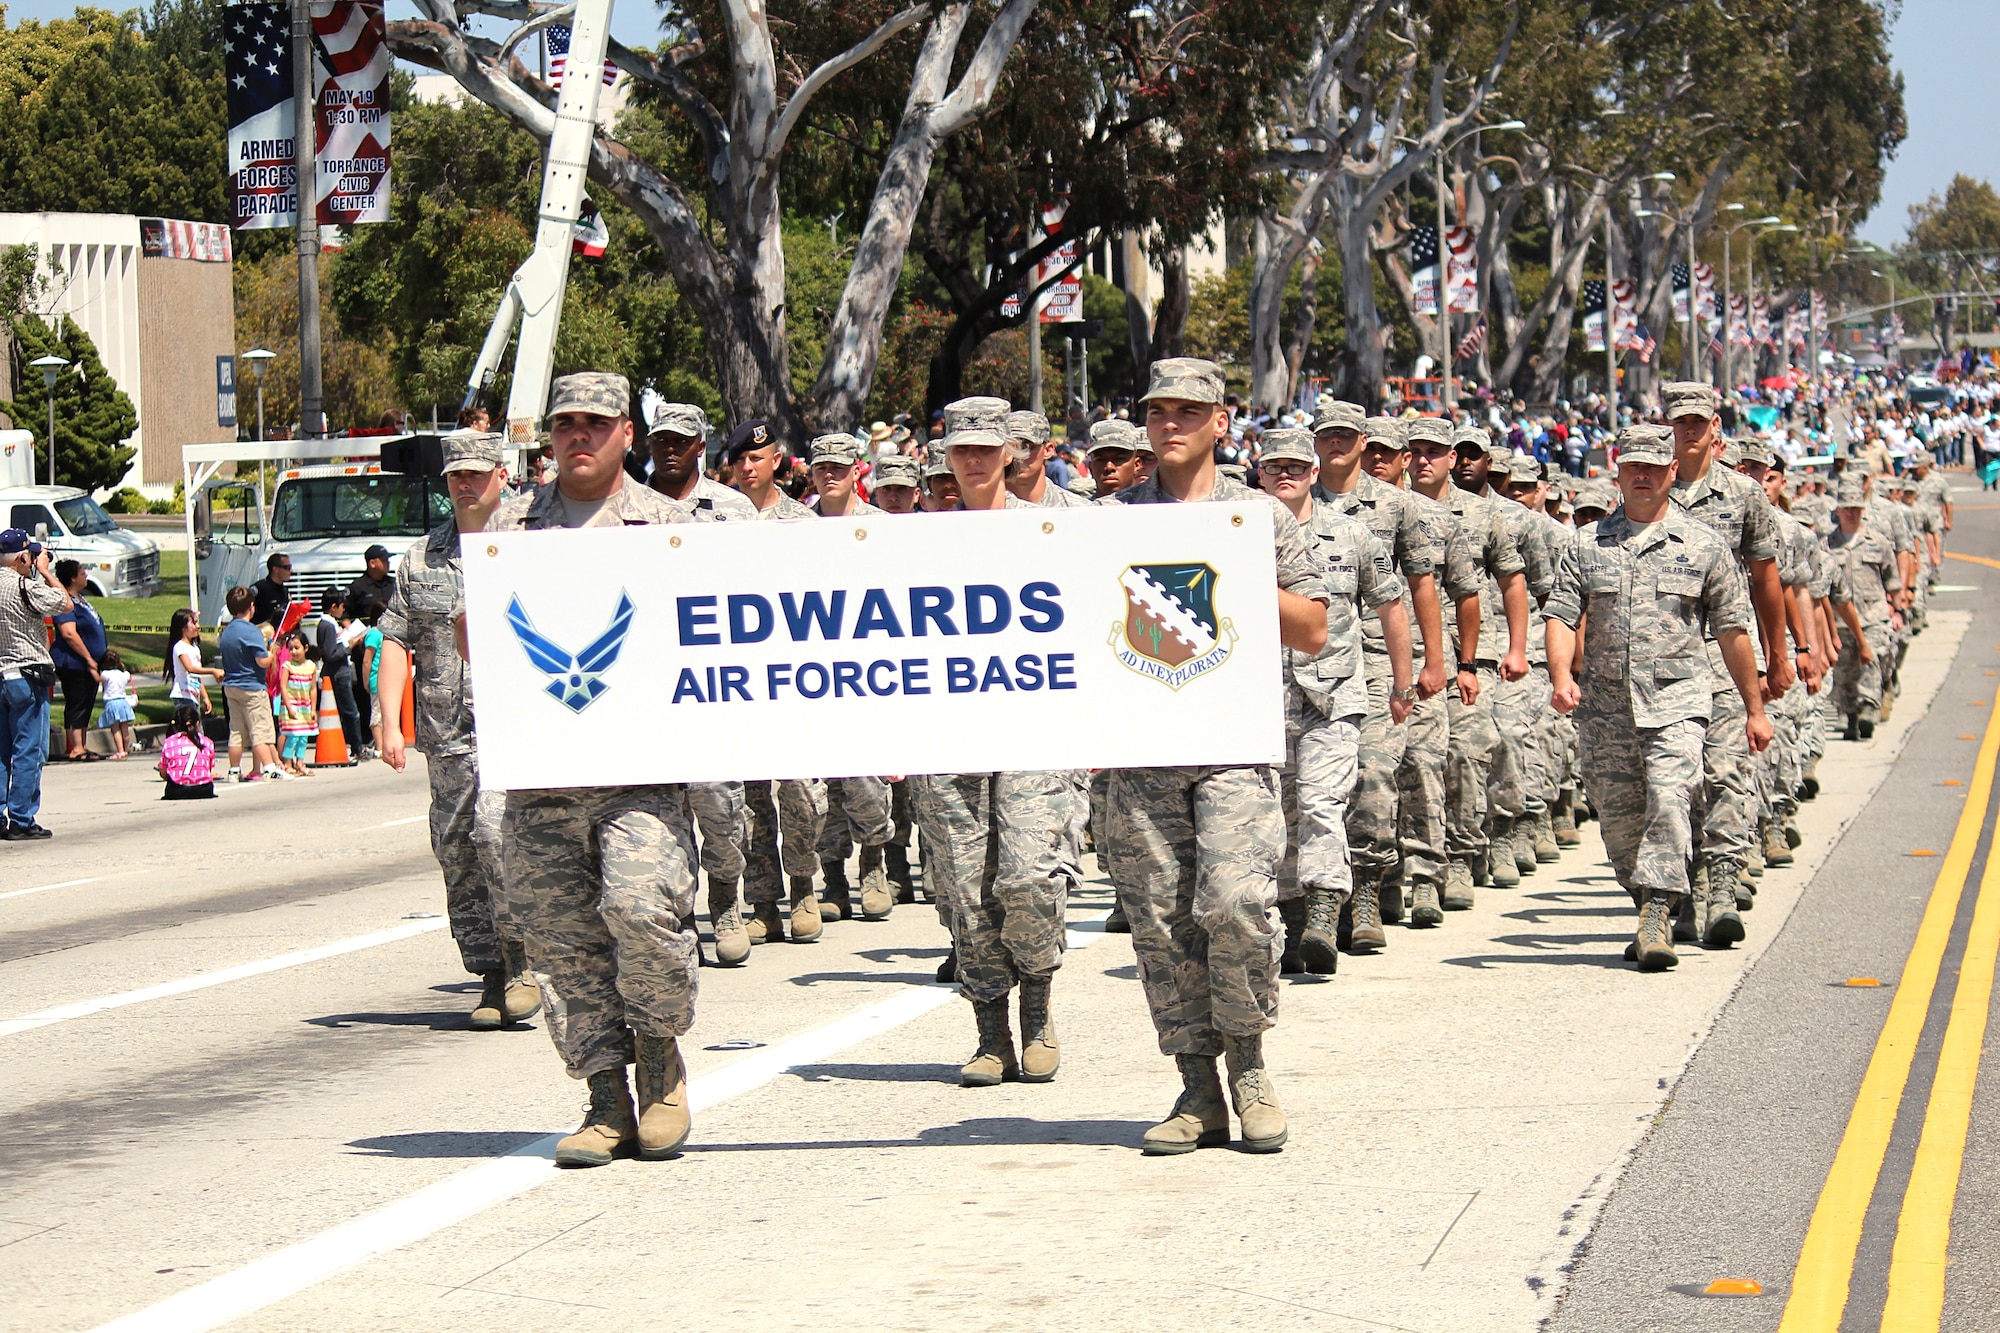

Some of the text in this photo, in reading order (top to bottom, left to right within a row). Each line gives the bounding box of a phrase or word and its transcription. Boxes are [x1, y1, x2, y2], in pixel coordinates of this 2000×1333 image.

[326, 89, 373, 105] MAY 19
[327, 108, 380, 125] 1:30 PM
[240, 138, 296, 161] ARMED
[324, 157, 386, 173] TORRANCE
[238, 166, 297, 189] FORCES
[338, 177, 370, 192] CIVIC
[238, 194, 297, 217] PARADE
[331, 195, 376, 211] CENTER
[676, 581, 1065, 646] EDWARDS
[1119, 647, 1228, 686] AD INEXPLORATA
[671, 653, 1078, 704] AIR FORCE BASE
[181, 746, 198, 776] 7
